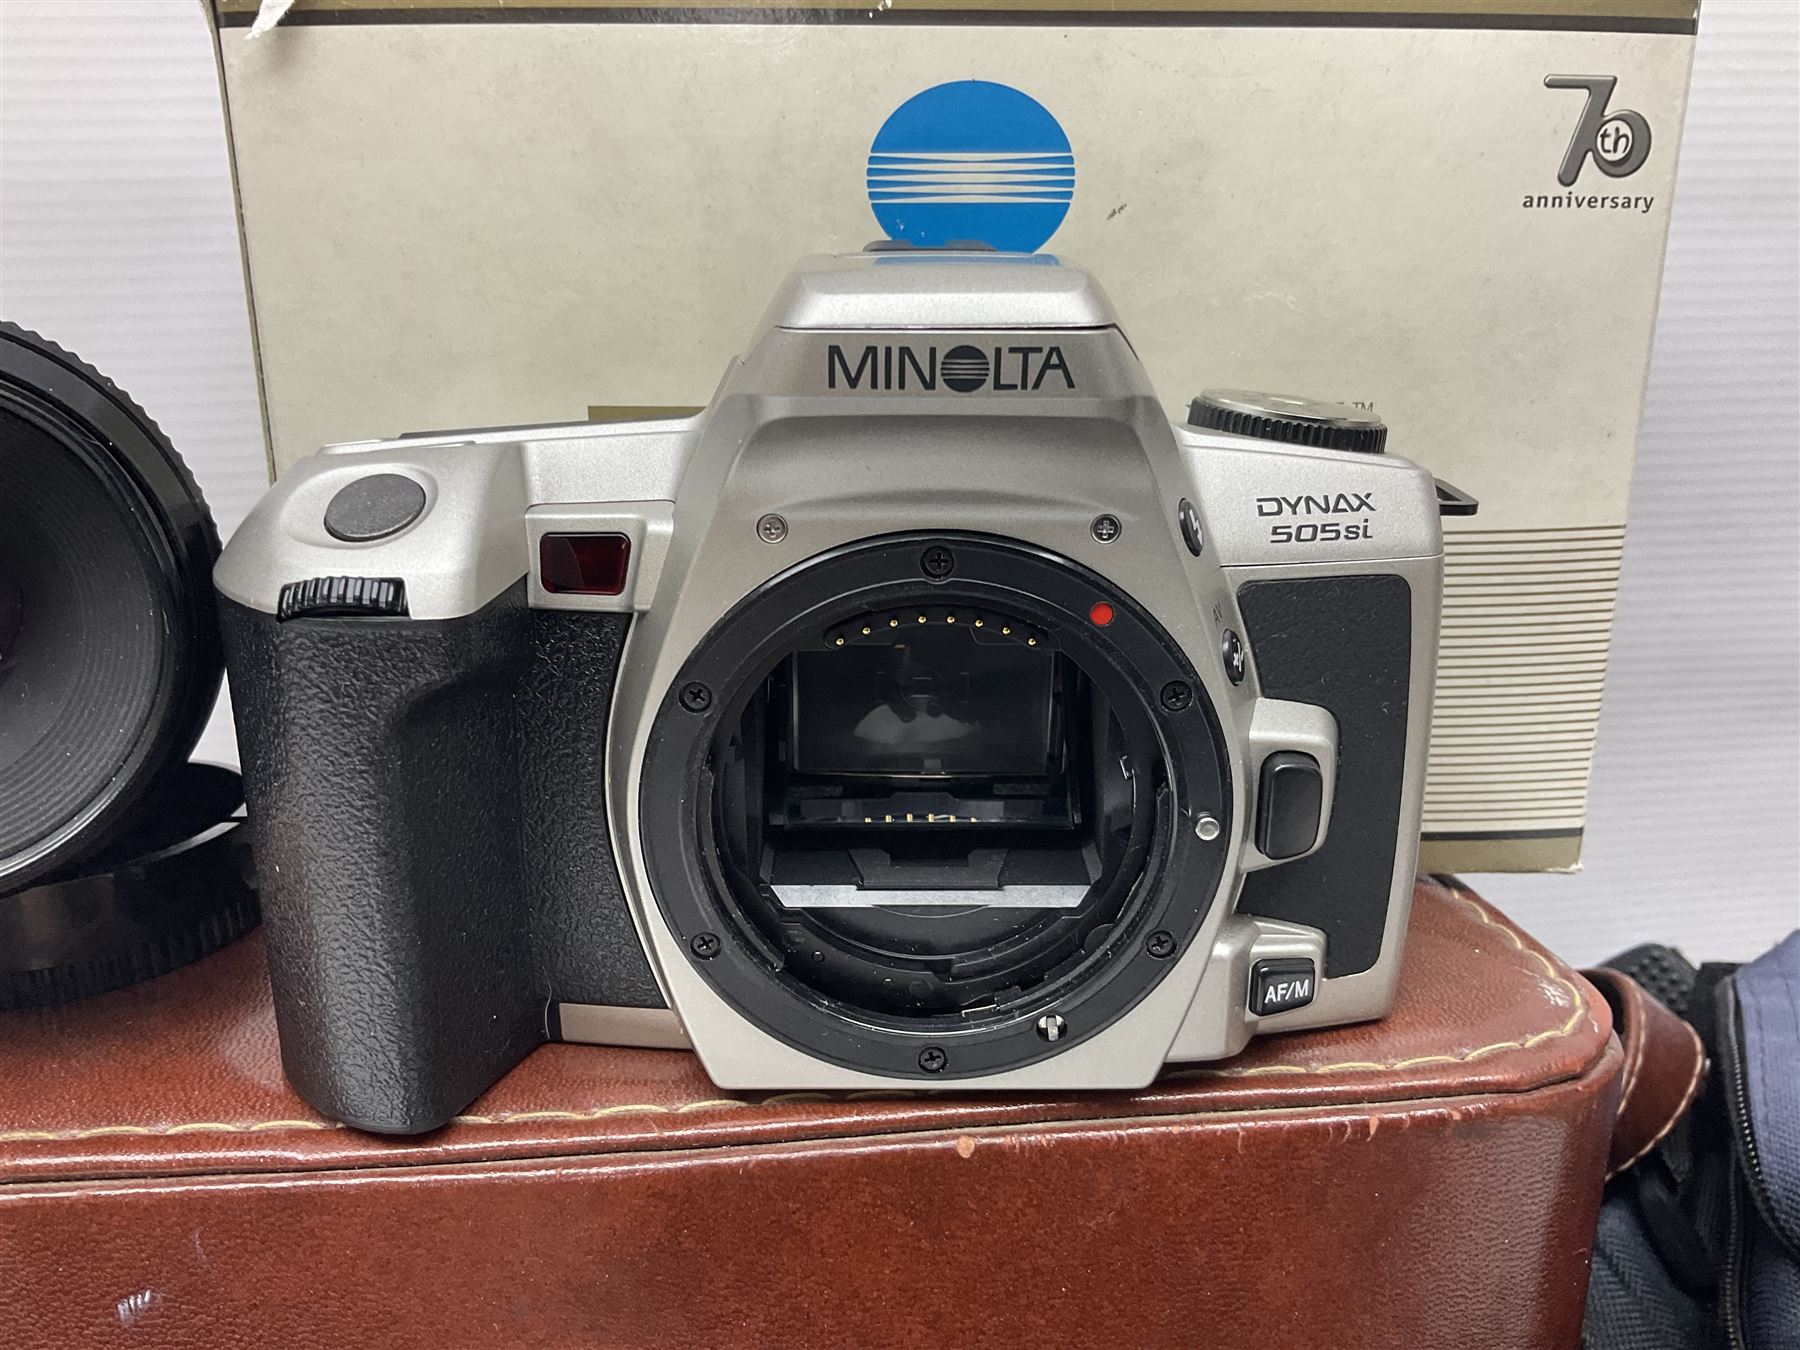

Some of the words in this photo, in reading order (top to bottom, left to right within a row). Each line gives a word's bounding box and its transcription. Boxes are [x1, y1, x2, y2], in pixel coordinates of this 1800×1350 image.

[1522, 191, 1655, 213] anniversary
[828, 345, 1076, 393] MINOLTA
[1256, 493, 1376, 517] DYNAX
[1270, 519, 1373, 543] 505si
[1264, 979, 1309, 1003] AF/M
